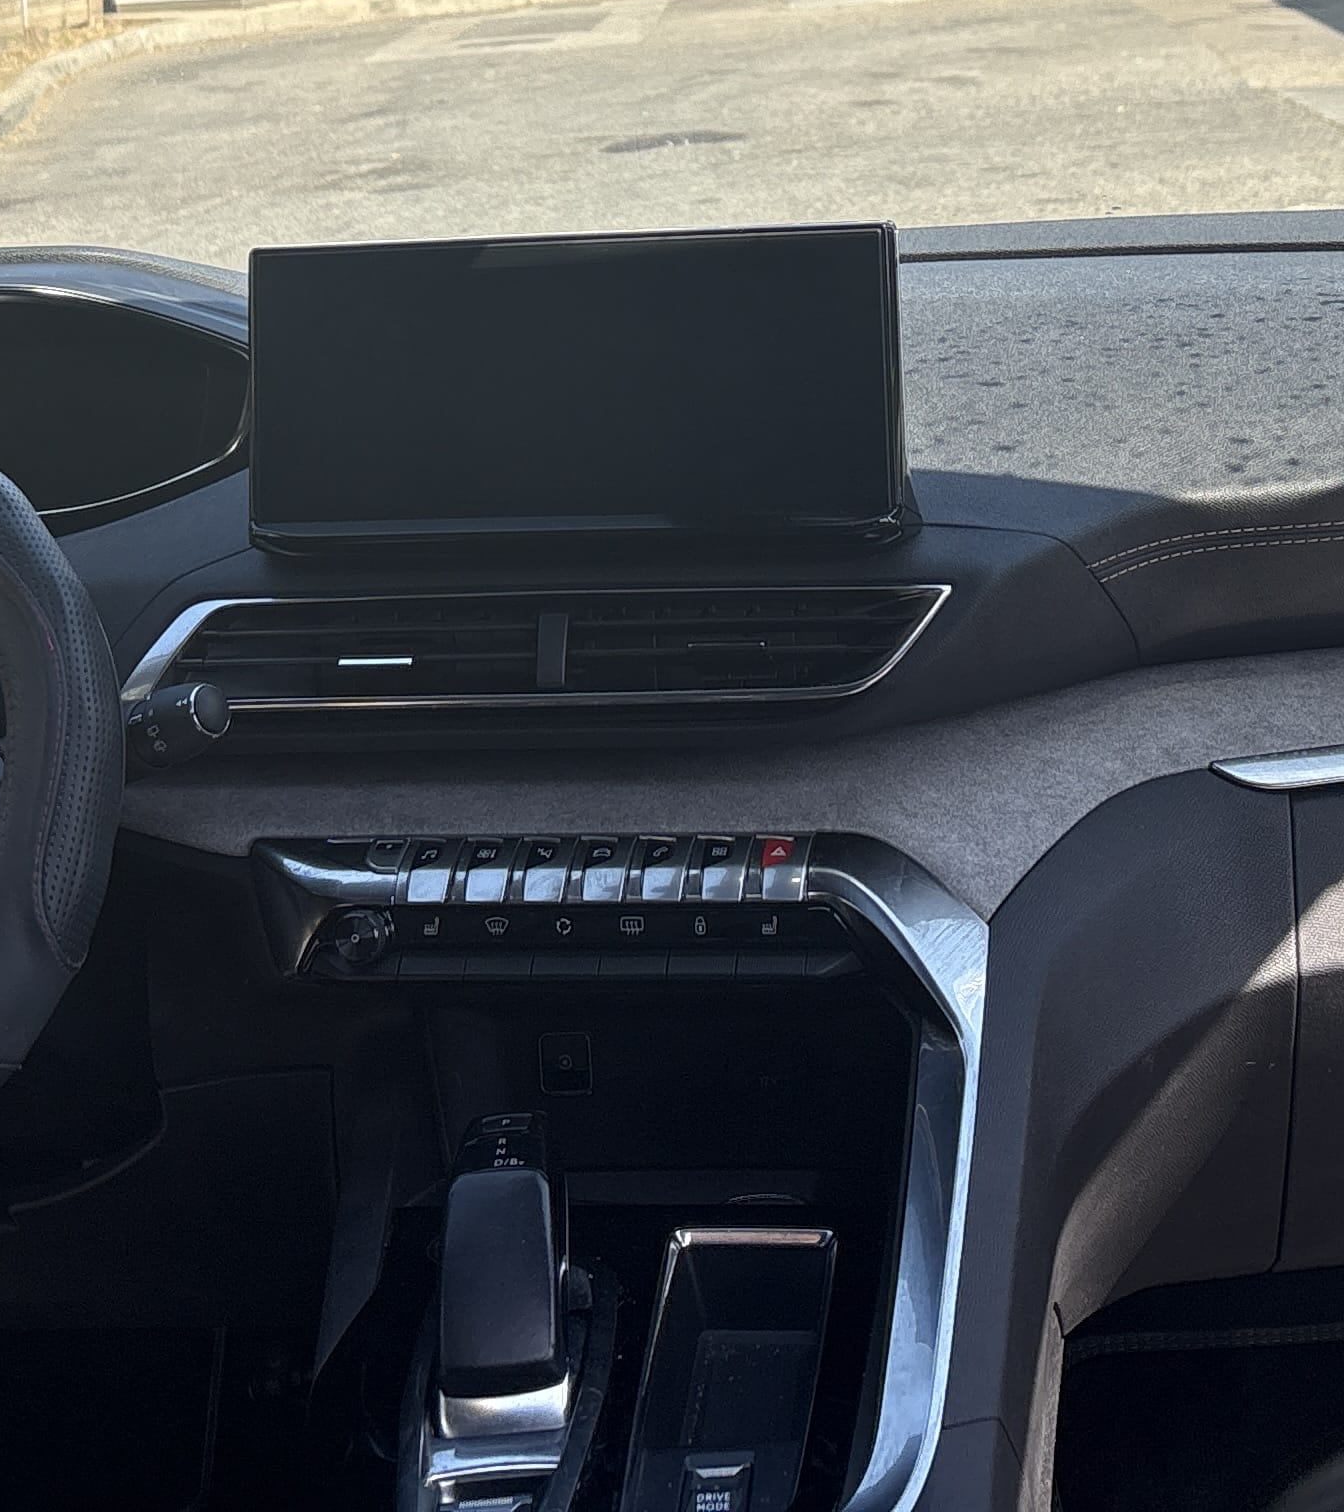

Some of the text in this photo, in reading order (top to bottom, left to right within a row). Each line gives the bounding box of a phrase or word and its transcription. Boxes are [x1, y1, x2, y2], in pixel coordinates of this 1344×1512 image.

[496, 1148, 507, 1156] N
[697, 1491, 731, 1503] DRIVE
[697, 1502, 731, 1512] MODE
